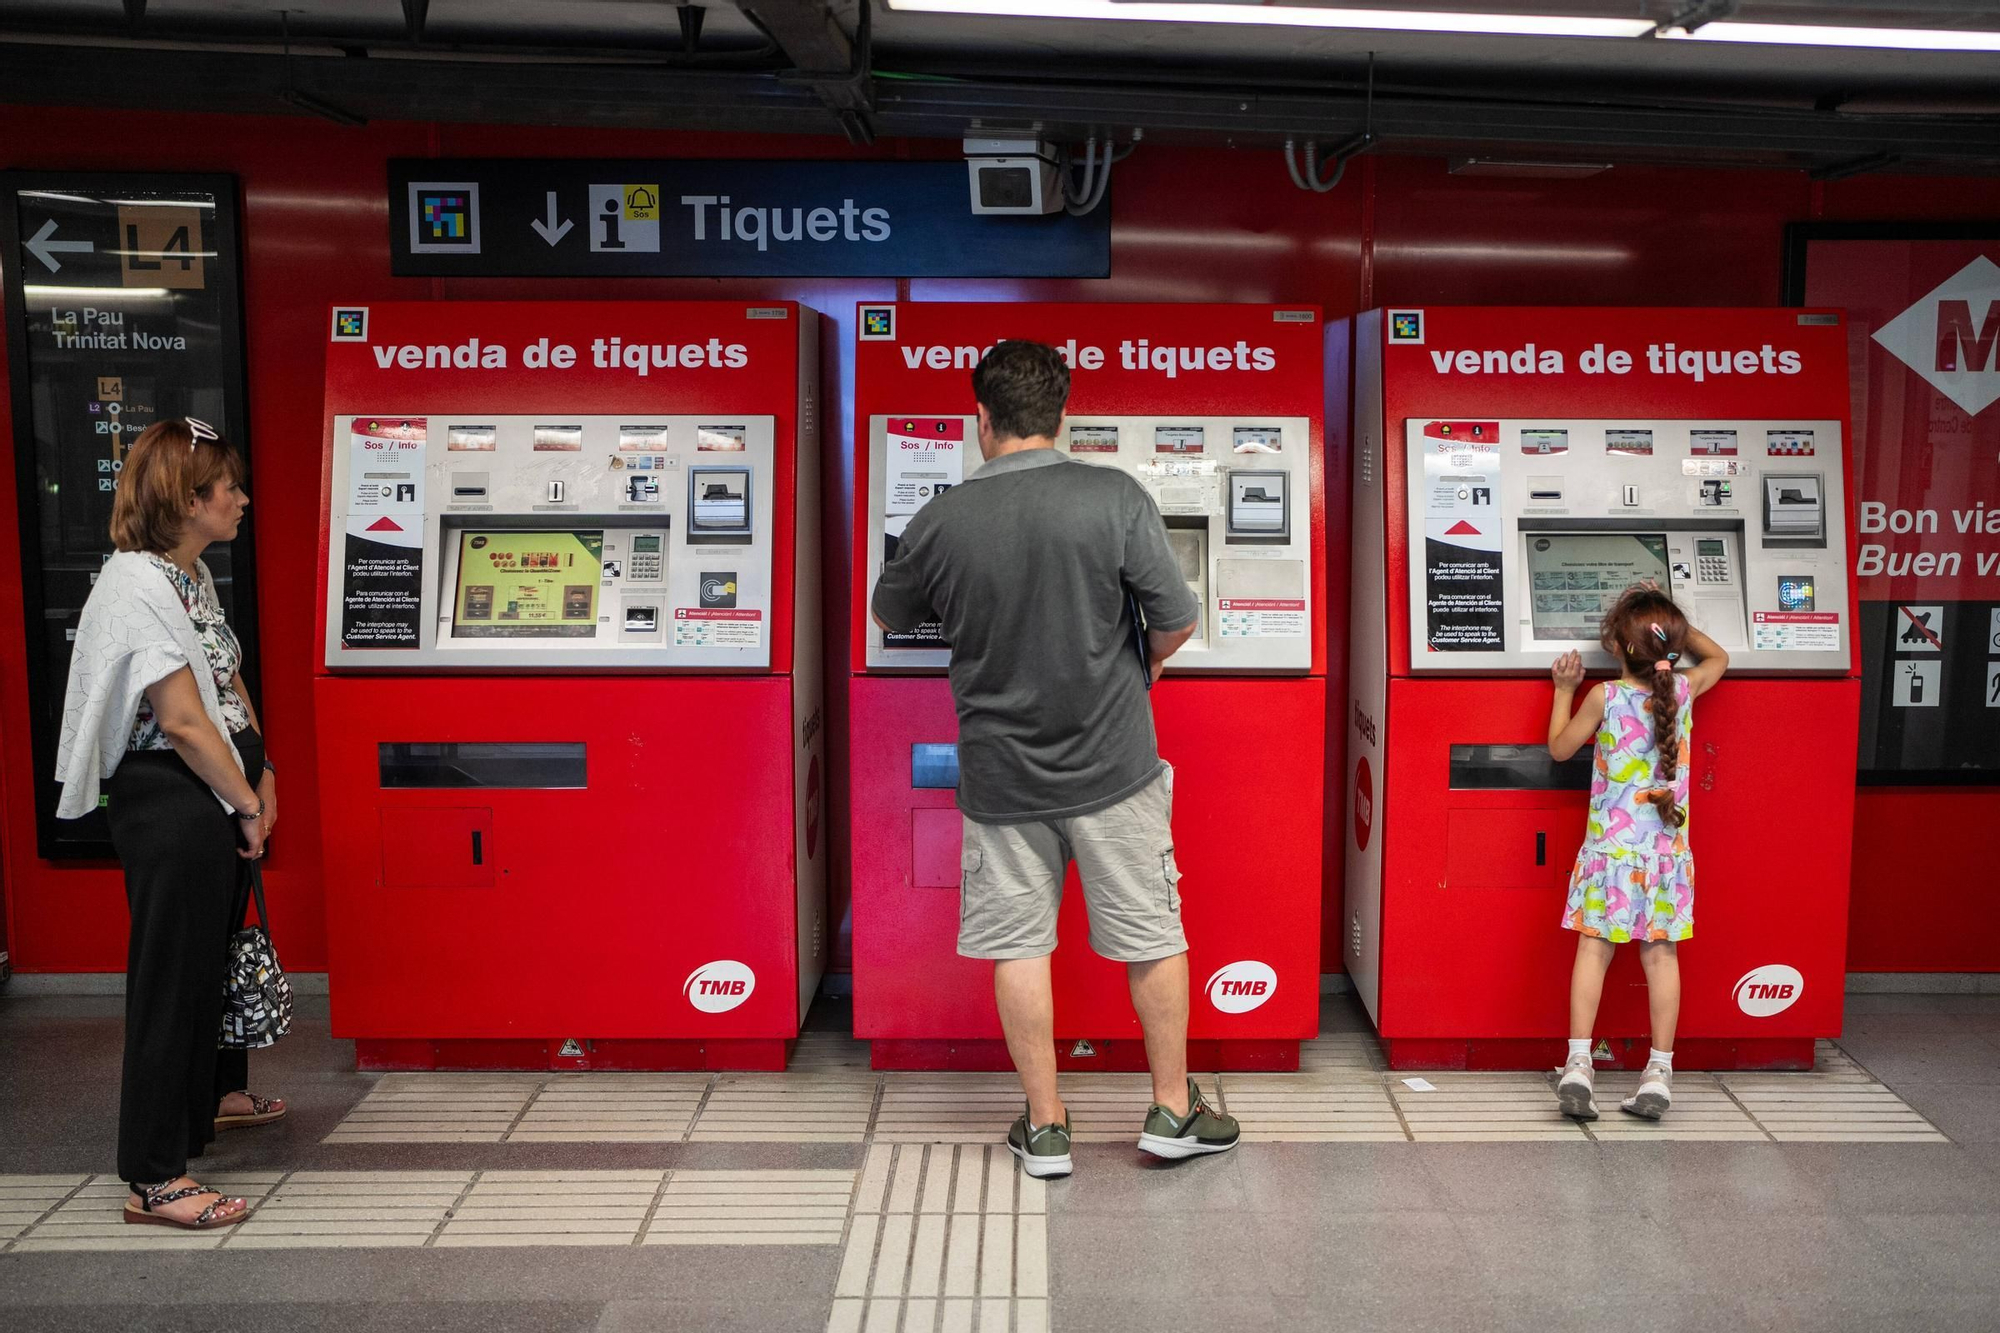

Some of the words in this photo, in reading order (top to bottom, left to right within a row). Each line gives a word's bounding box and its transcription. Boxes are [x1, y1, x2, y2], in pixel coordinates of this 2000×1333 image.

[634, 210, 649, 218] Sos
[681, 196, 891, 251] Tiquets
[126, 224, 195, 270] L4
[52, 307, 77, 325] La
[83, 307, 123, 325] Pau
[52, 332, 127, 349] Trinitat
[133, 332, 186, 350] Nova
[372, 338, 507, 369] venda
[522, 338, 577, 368] de
[591, 337, 748, 376] tiquets
[901, 341, 1004, 370] ven
[1061, 339, 1105, 370] de
[1119, 339, 1276, 378] tiquets
[1429, 343, 1564, 373] venda
[1578, 343, 1632, 373] de
[1646, 343, 1801, 381] tiquets
[101, 382, 120, 395] L4
[90, 404, 100, 412] L2
[127, 424, 147, 432] Besò
[365, 441, 383, 449] Sos
[398, 441, 417, 449] Info
[901, 441, 920, 449] Sos
[935, 441, 954, 450] Info
[1438, 444, 1456, 452] Sos
[1471, 444, 1490, 452] Info
[1860, 501, 1938, 534] Bon
[1856, 544, 1961, 576] Buen
[1355, 699, 1376, 747] tiquets
[1357, 787, 1370, 827] TMB
[699, 980, 746, 995] TMB
[1221, 981, 1268, 996] TMB
[1748, 985, 1794, 999] TMB
